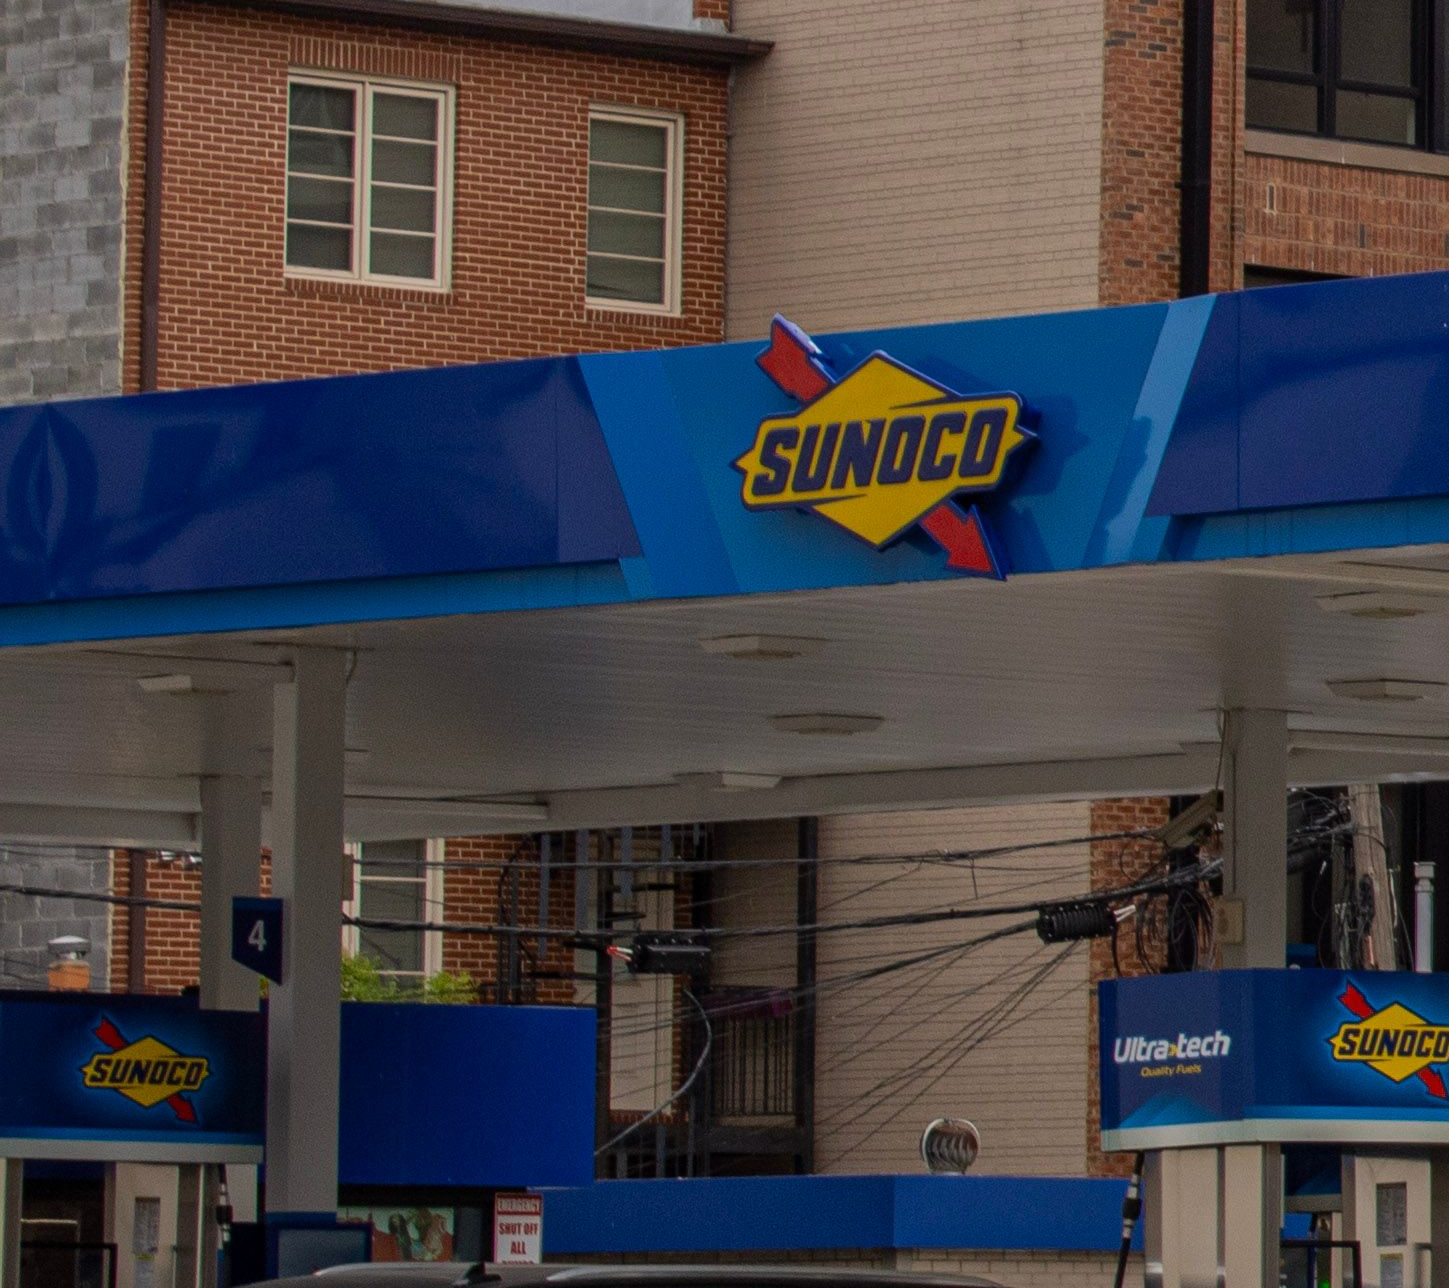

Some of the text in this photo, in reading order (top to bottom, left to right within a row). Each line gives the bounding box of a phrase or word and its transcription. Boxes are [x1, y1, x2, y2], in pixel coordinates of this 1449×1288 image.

[750, 406, 1009, 497] SUNOCO
[247, 919, 268, 952] 4
[89, 1058, 204, 1087] SUNOCO
[1140, 1063, 1202, 1078] Quality Fuels
[499, 1222, 539, 1235] SHUT OFF
[510, 1241, 527, 1255] ALL
